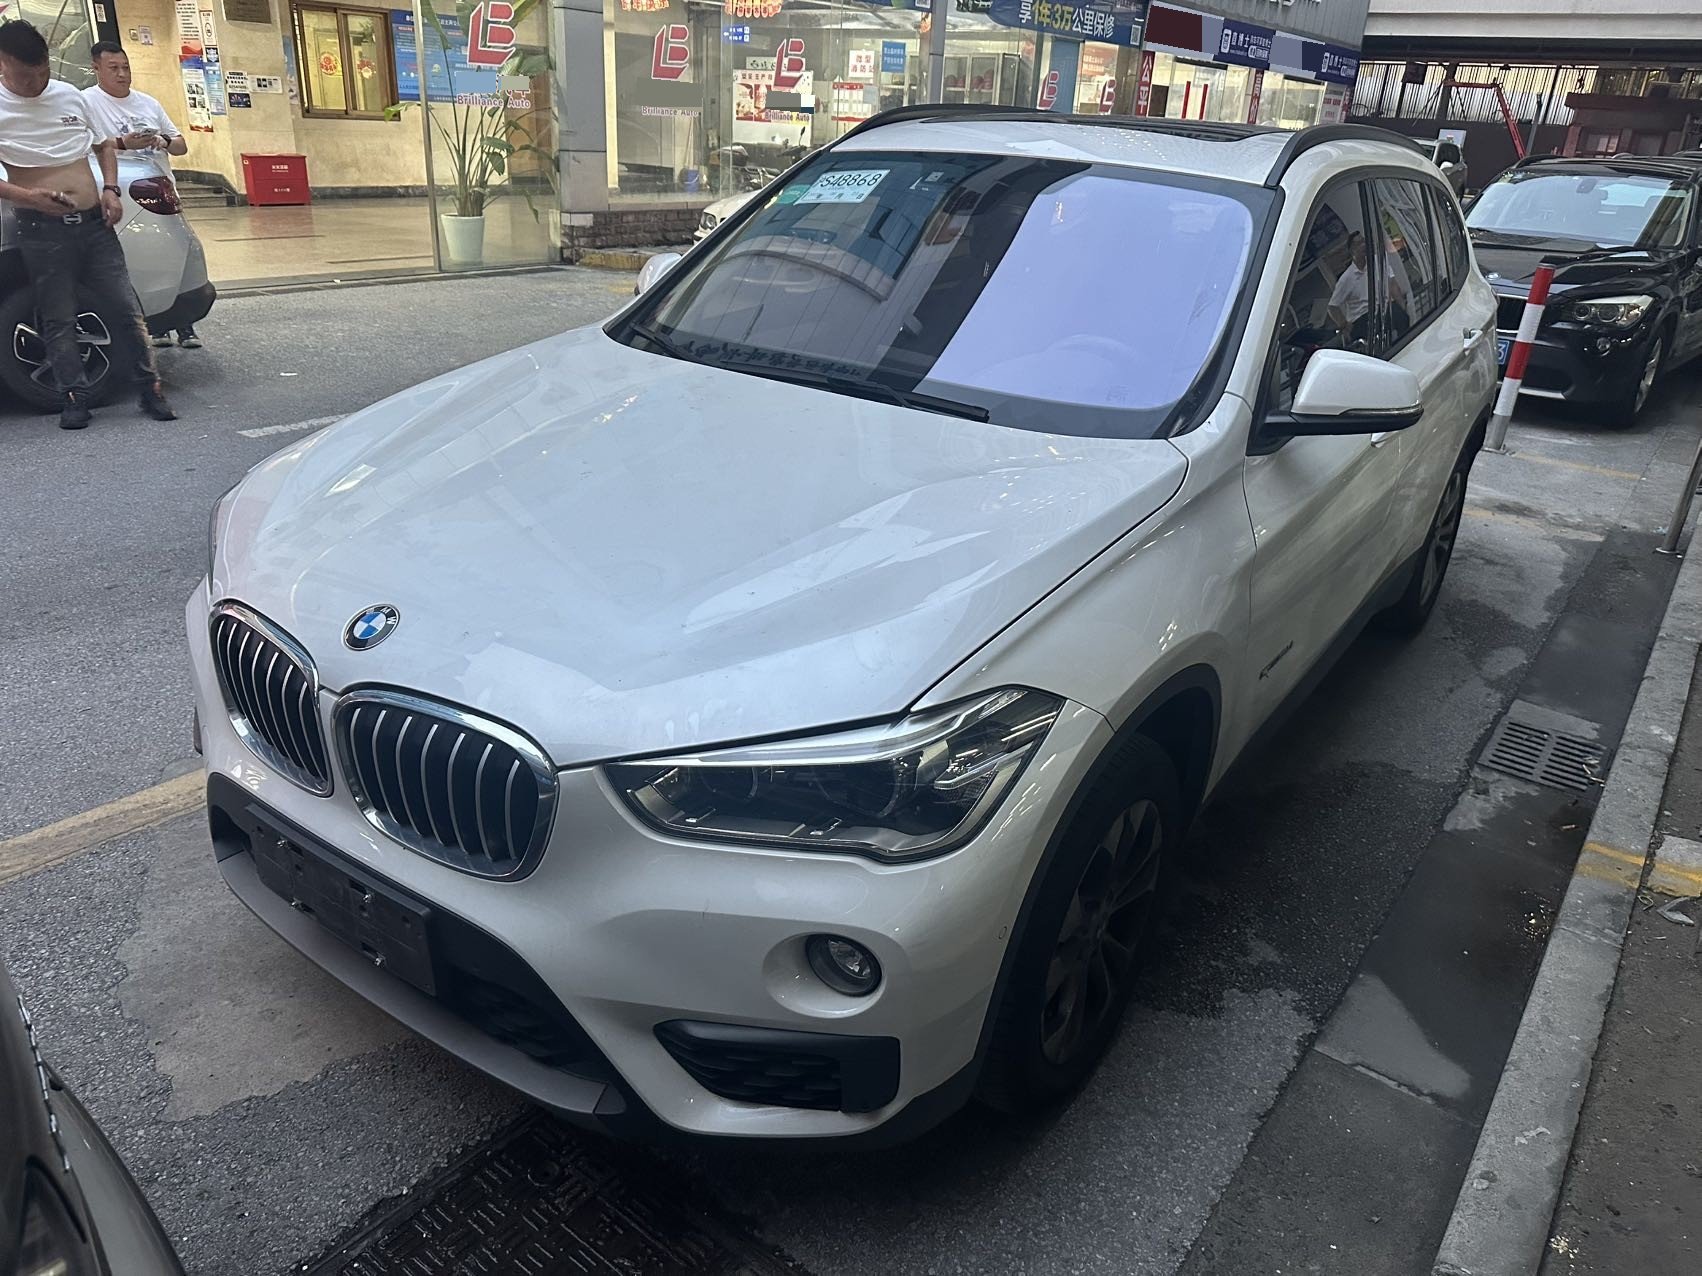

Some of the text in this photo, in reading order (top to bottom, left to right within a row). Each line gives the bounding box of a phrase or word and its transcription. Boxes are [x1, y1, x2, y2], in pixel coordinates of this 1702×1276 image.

[1138, 55, 1153, 114] 公平
[457, 94, 531, 108] Brilliance Auto
[641, 105, 678, 117] Brilliance
[764, 109, 810, 122] Brilliance Auto
